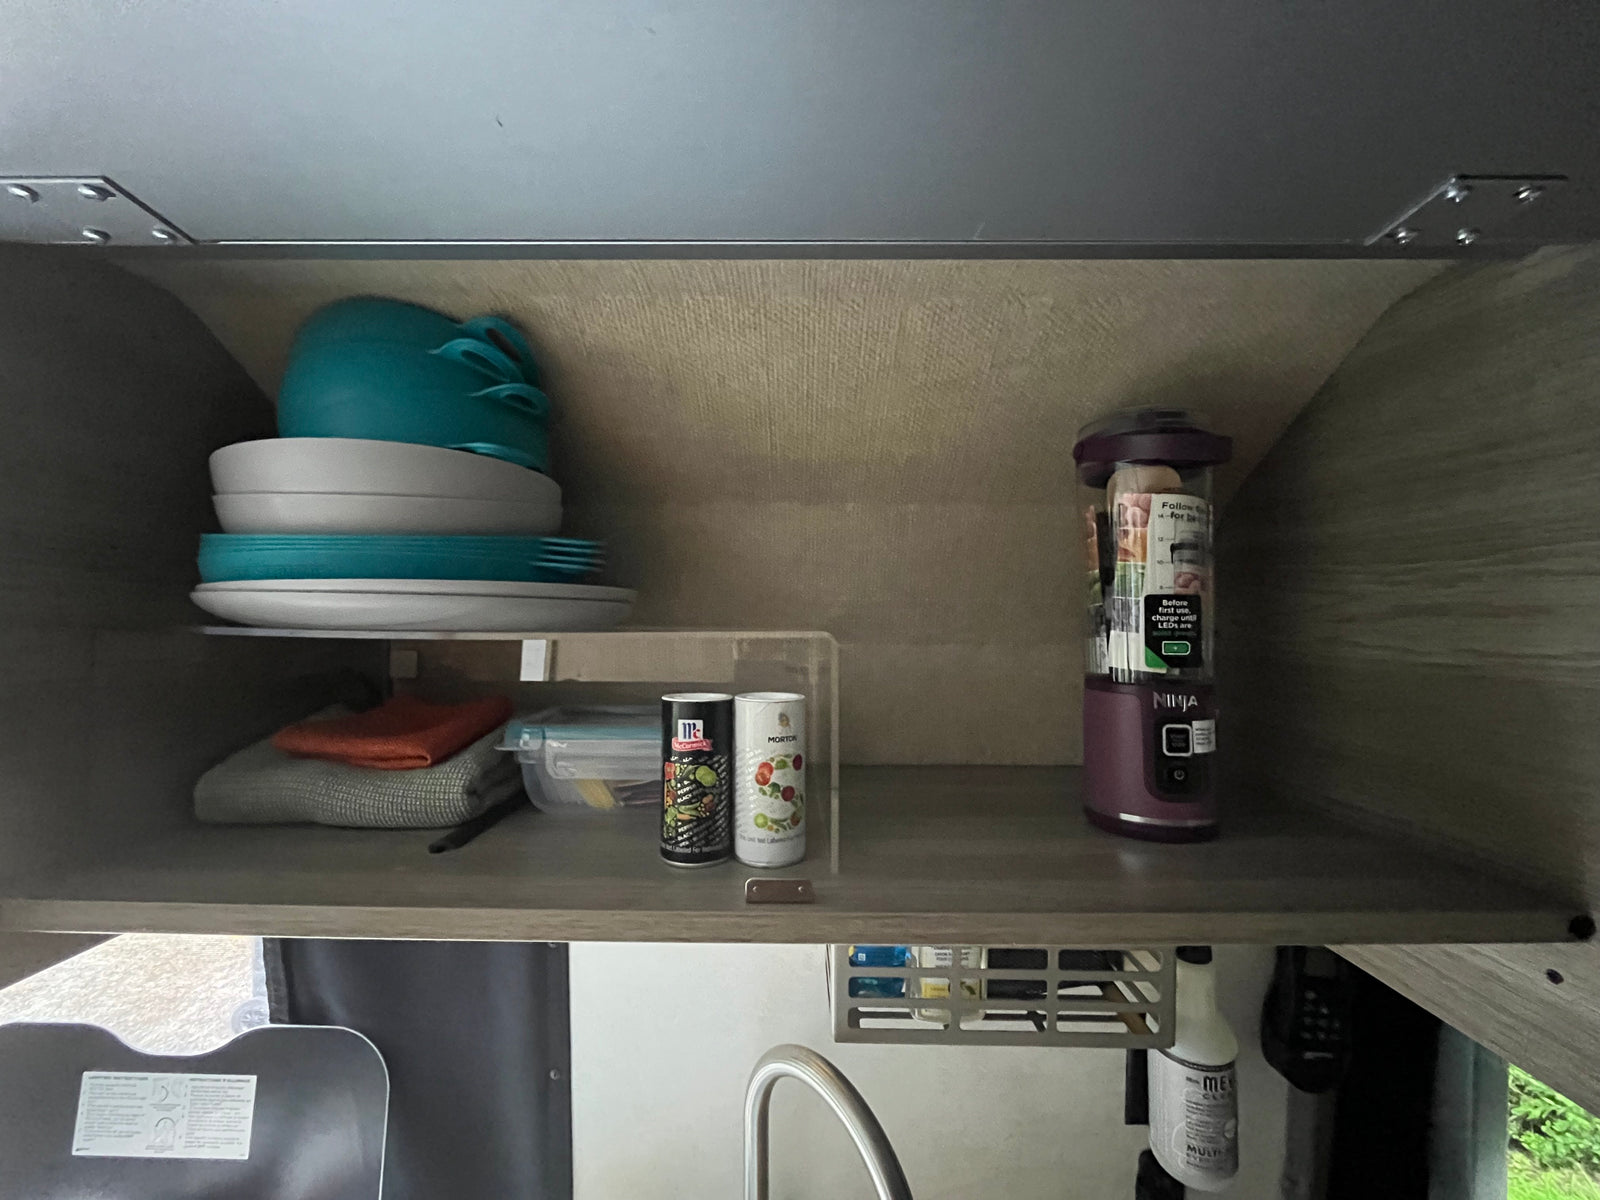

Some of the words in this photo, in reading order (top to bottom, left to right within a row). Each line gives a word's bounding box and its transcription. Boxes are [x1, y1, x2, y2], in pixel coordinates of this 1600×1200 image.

[1170, 511, 1184, 520] for
[1158, 606, 1175, 614] first
[1151, 614, 1180, 622] charge
[1158, 621, 1178, 629] LEDs
[1153, 691, 1198, 712] NINJA
[768, 735, 798, 743] MORTON
